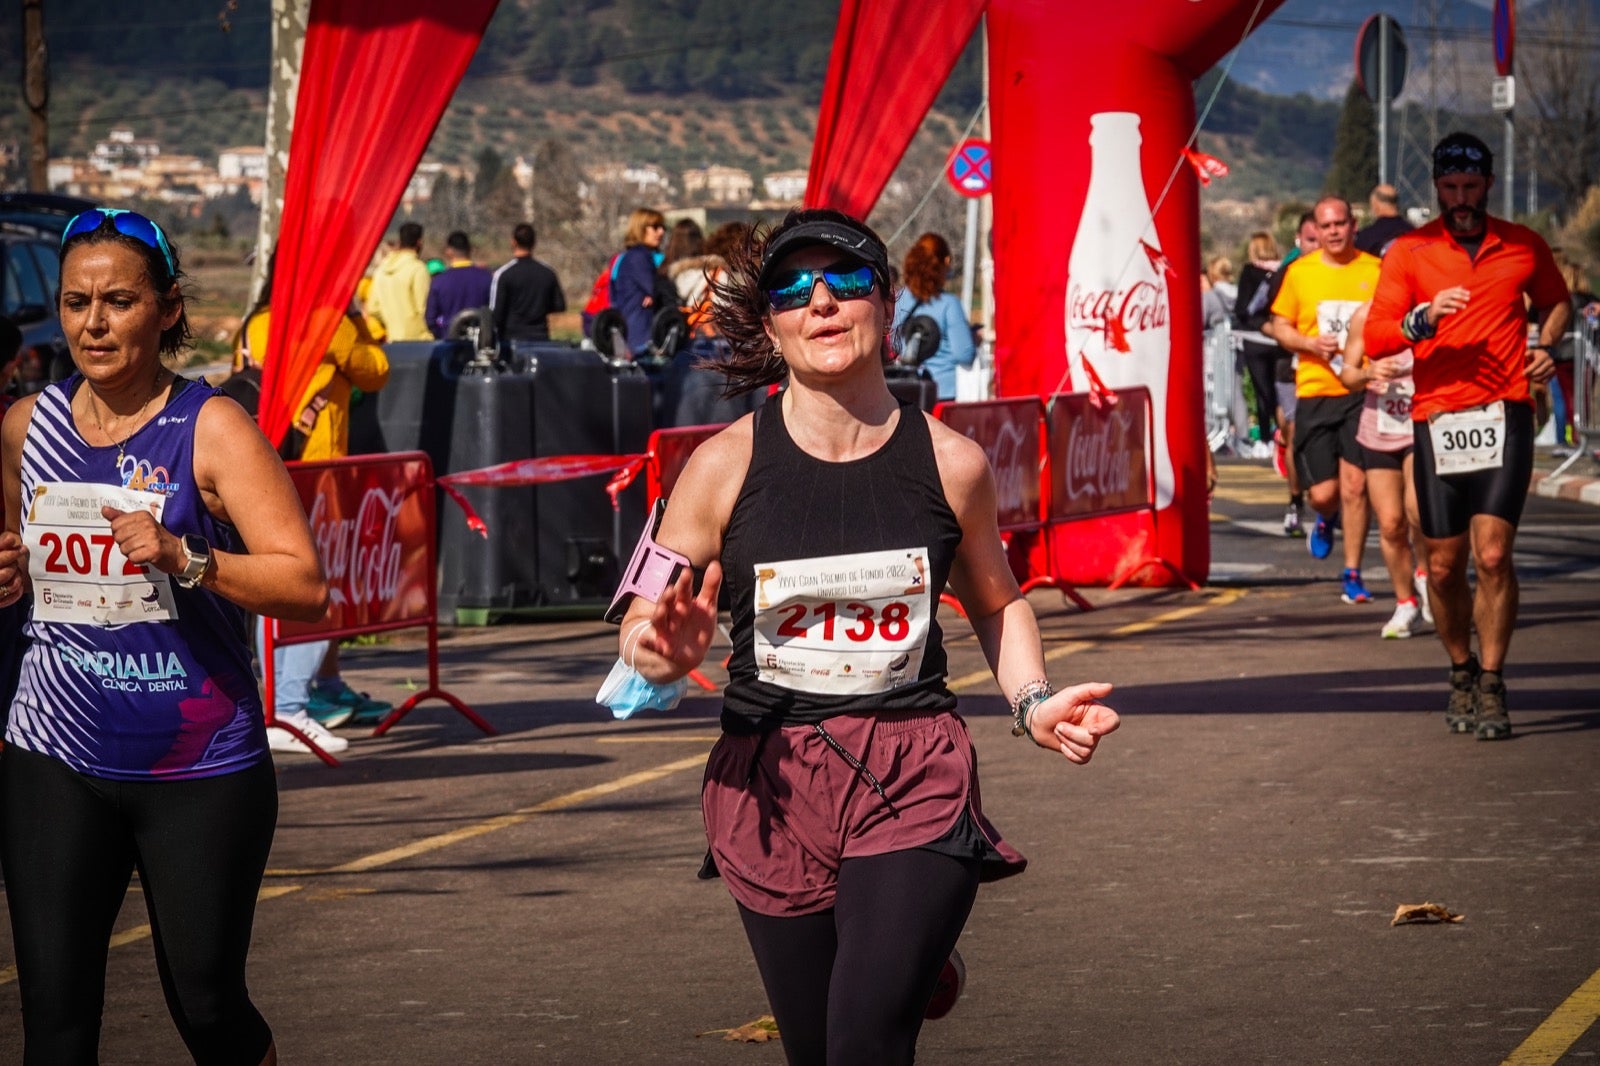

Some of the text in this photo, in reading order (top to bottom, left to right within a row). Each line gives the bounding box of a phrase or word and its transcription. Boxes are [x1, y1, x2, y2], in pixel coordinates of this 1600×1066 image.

[1070, 280, 1167, 332] Coca-Cola
[1442, 427, 1497, 451] 3003
[886, 564, 906, 578] 2022
[776, 601, 910, 642] 2138
[148, 680, 188, 693] DENTAL
